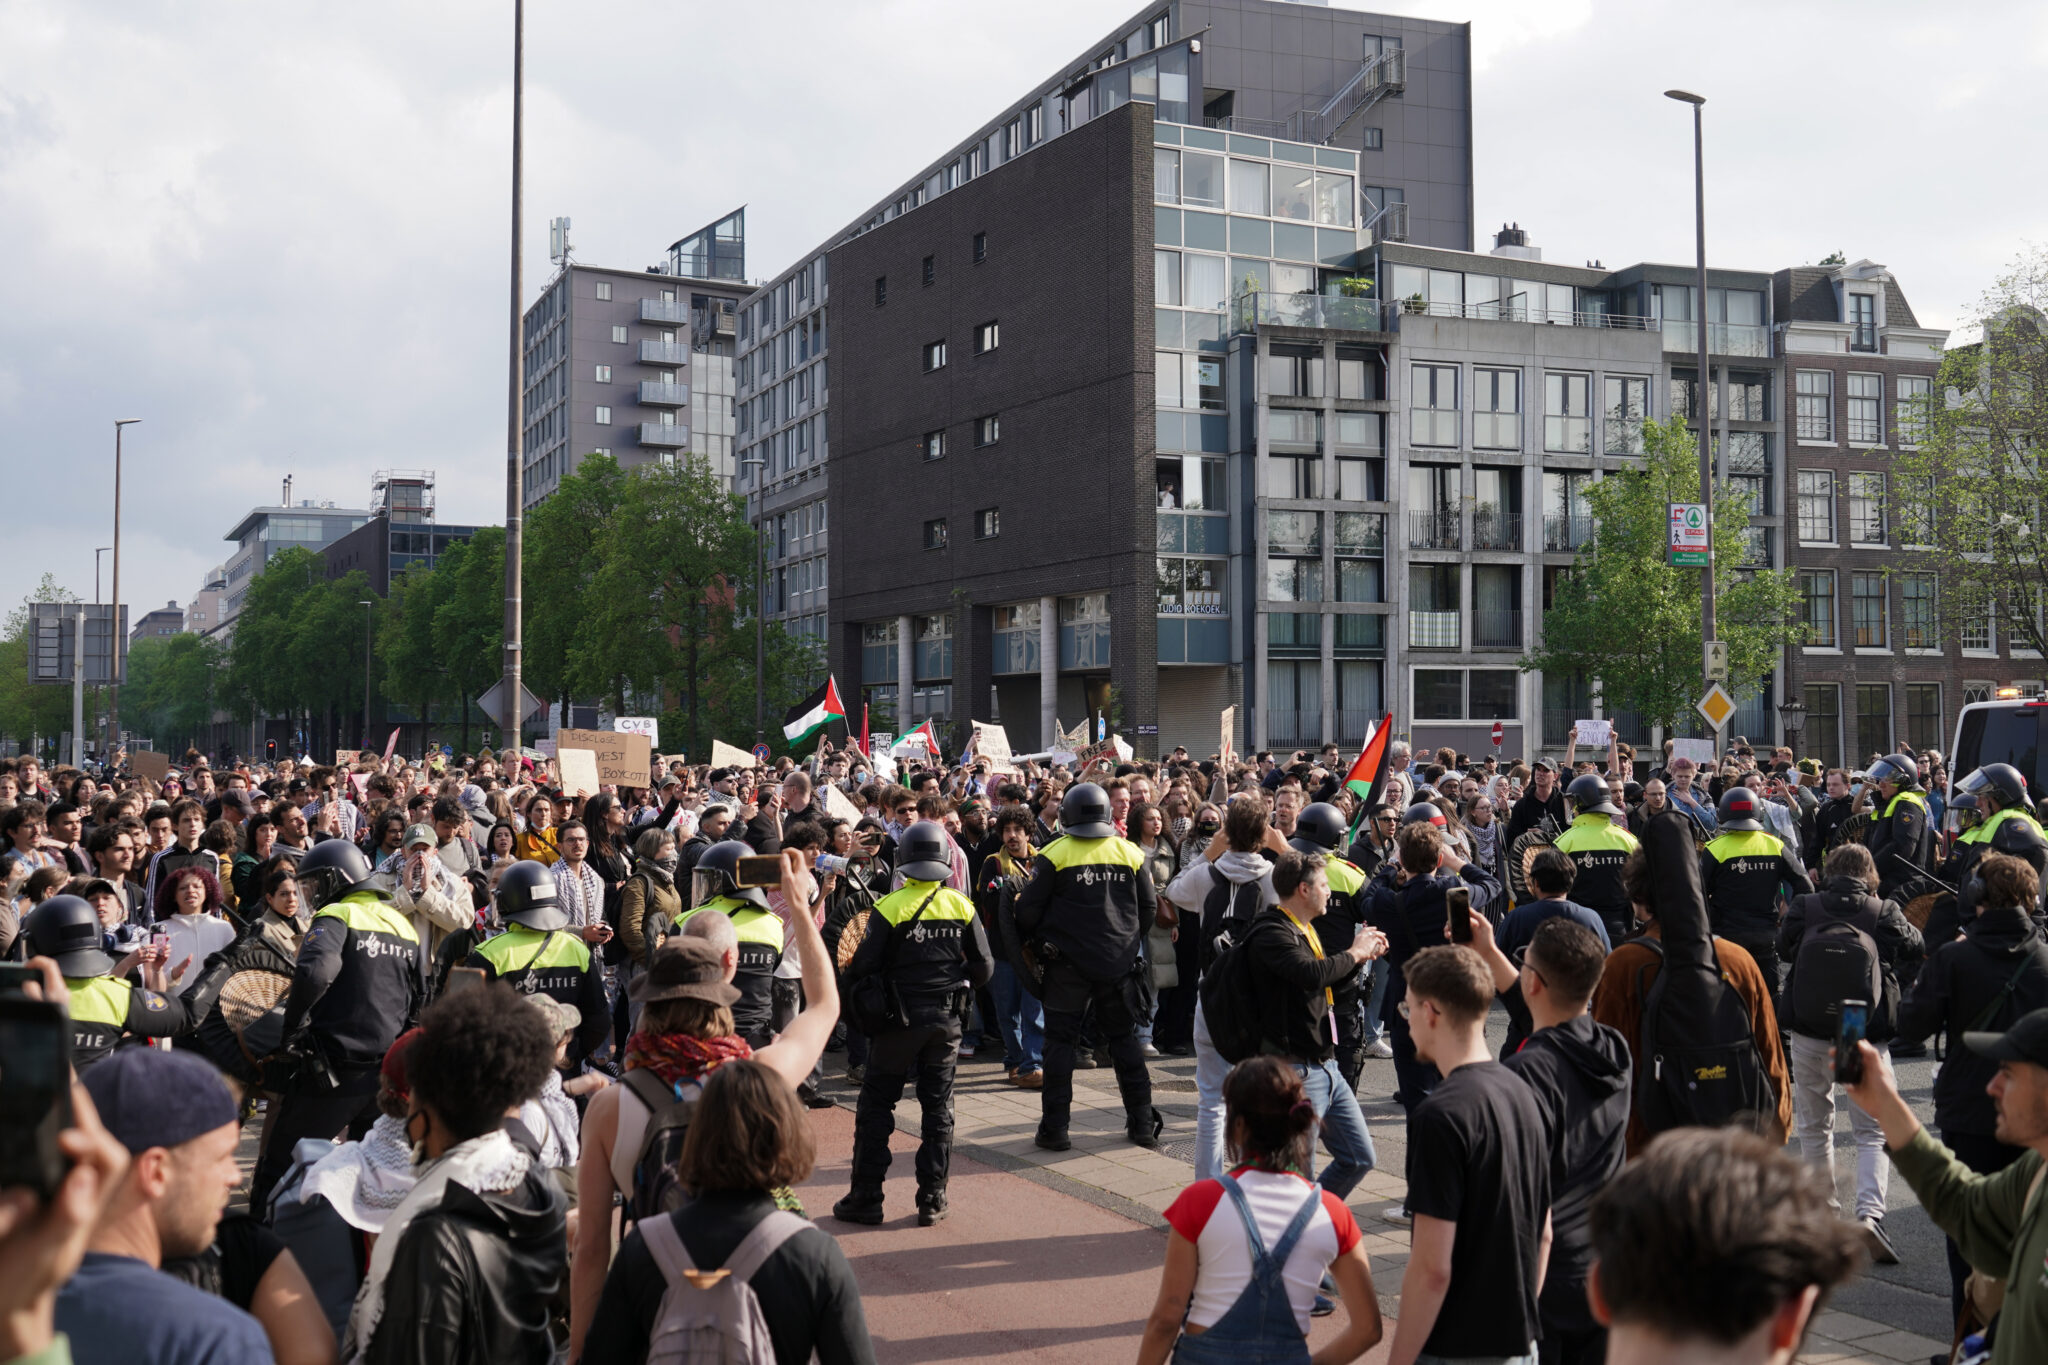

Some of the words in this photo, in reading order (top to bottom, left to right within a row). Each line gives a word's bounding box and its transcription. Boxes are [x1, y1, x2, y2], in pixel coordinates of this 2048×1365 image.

[1185, 604, 1220, 614] KOEKOEK
[622, 720, 651, 729] CVB
[1581, 721, 1602, 730] STOP
[571, 733, 616, 744] DISCLOSE
[1080, 742, 1107, 761] FREE
[601, 767, 648, 783] BOYCOTT
[1577, 854, 1624, 868] POLITIE
[1731, 859, 1775, 873] POLITIE
[1076, 868, 1126, 885] POLITIE
[515, 973, 577, 993] POLITIE
